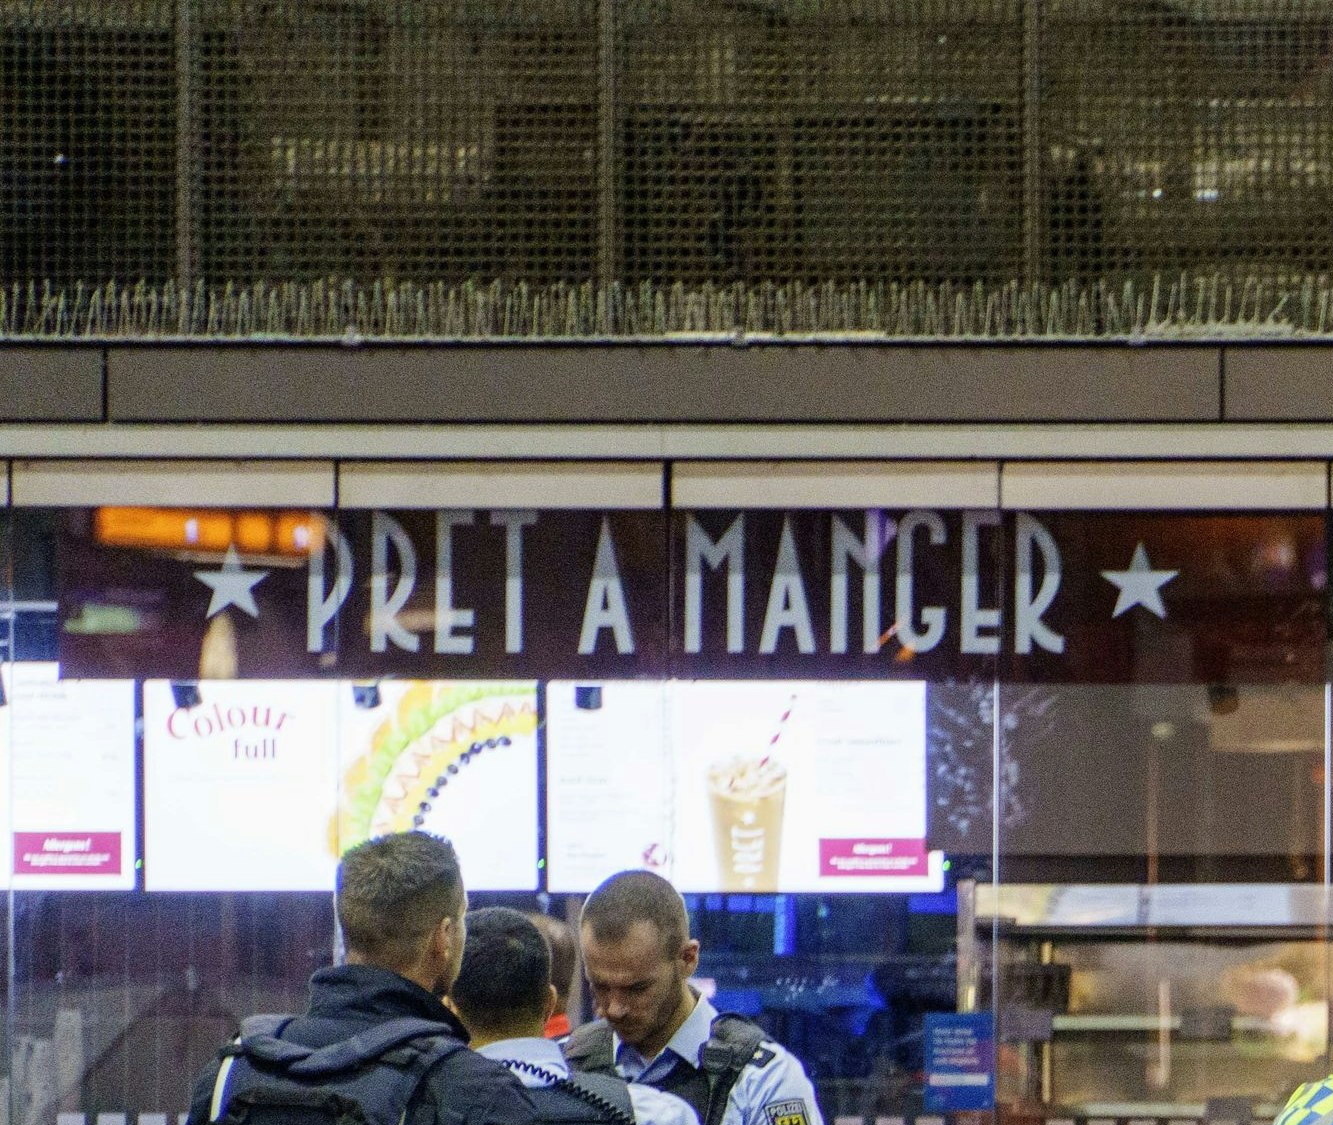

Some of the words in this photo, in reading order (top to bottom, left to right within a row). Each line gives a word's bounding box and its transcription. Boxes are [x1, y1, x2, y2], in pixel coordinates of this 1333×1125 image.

[306, 508, 537, 653] PRET
[577, 512, 635, 655] A
[684, 509, 1066, 655] MANGER
[166, 703, 290, 740] Colour
[233, 738, 277, 760] full
[768, 1102, 803, 1118] POLIZEI
